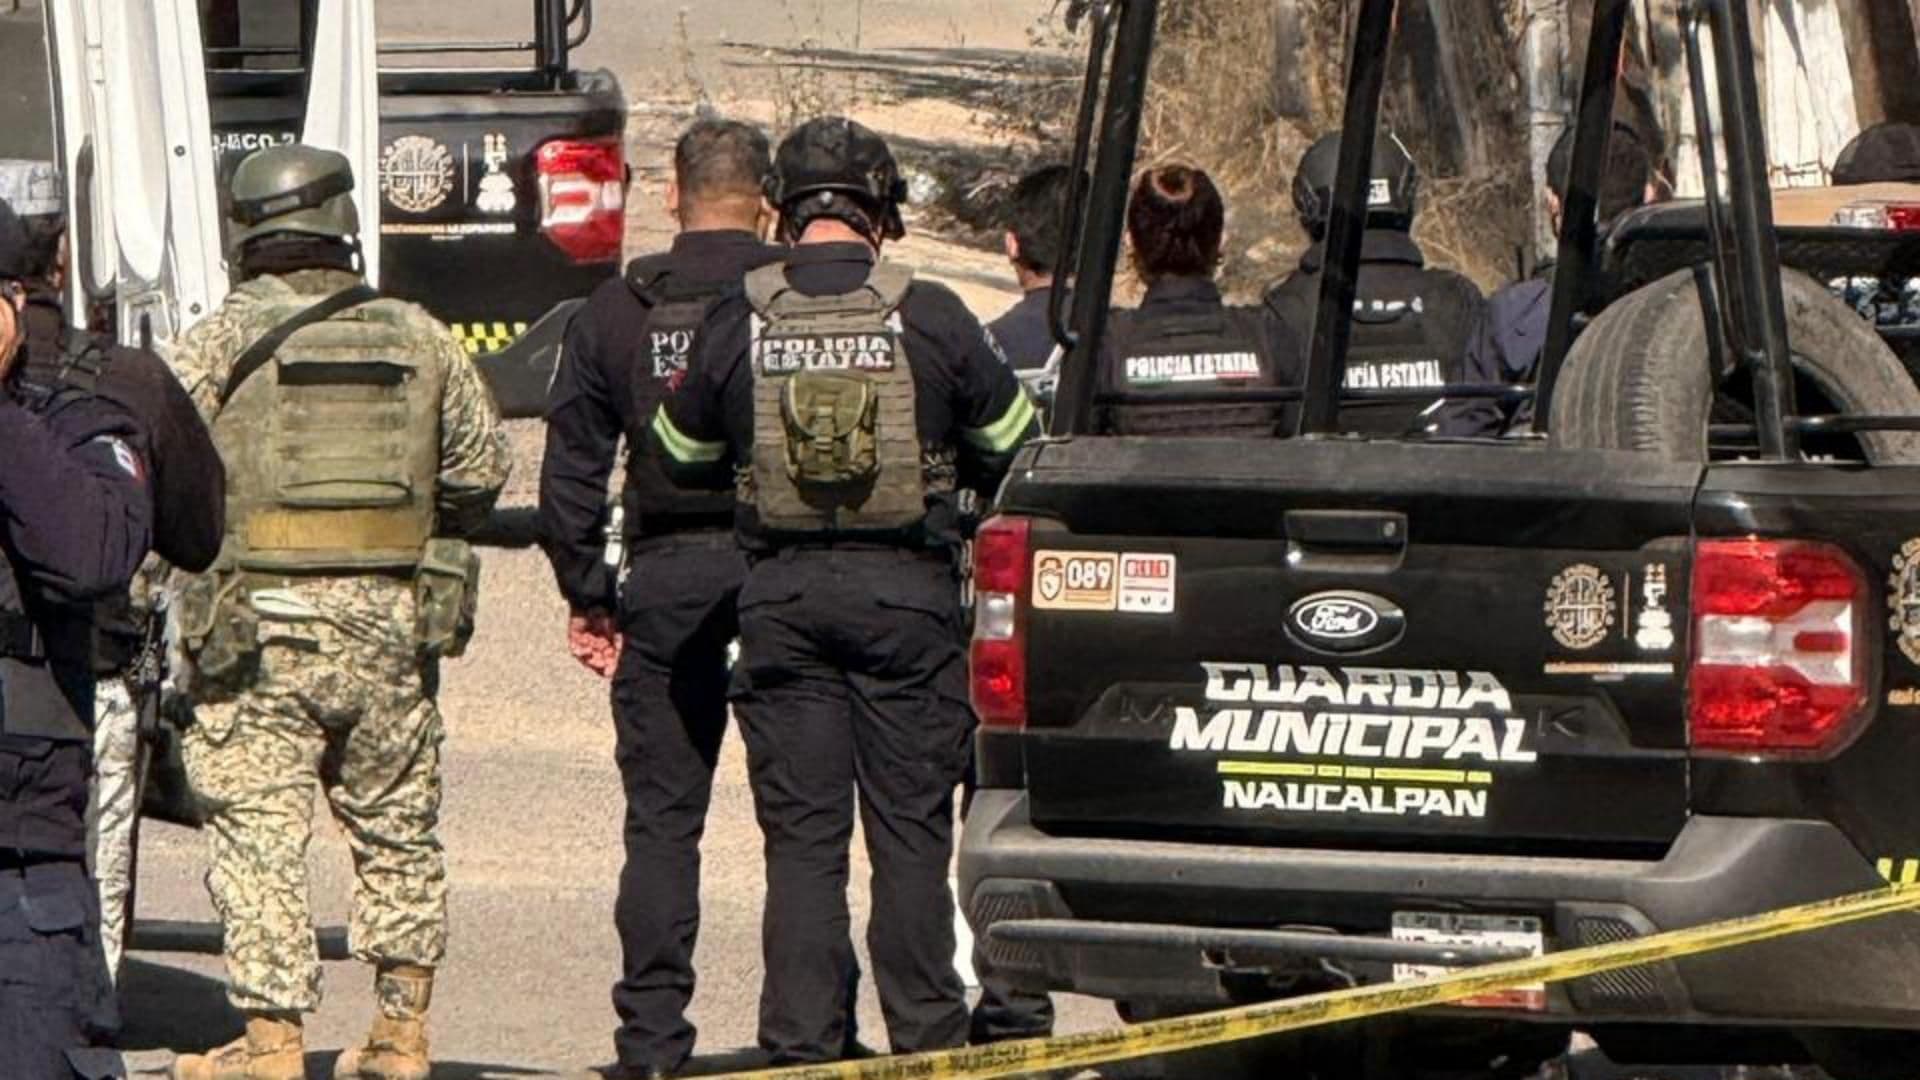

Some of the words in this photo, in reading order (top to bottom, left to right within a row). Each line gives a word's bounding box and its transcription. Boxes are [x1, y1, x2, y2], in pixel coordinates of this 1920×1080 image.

[650, 330, 695, 353] PO
[763, 351, 893, 371] ESTATAL
[1193, 352, 1260, 375] ESTATAL
[1381, 360, 1445, 388] ESTATAL
[1067, 559, 1112, 588] 089
[1311, 603, 1362, 632] Ford
[1200, 661, 1513, 712] GUARDIA
[1169, 706, 1537, 763] MUNICIPAL
[1223, 779, 1487, 817] NAUCALPAN
